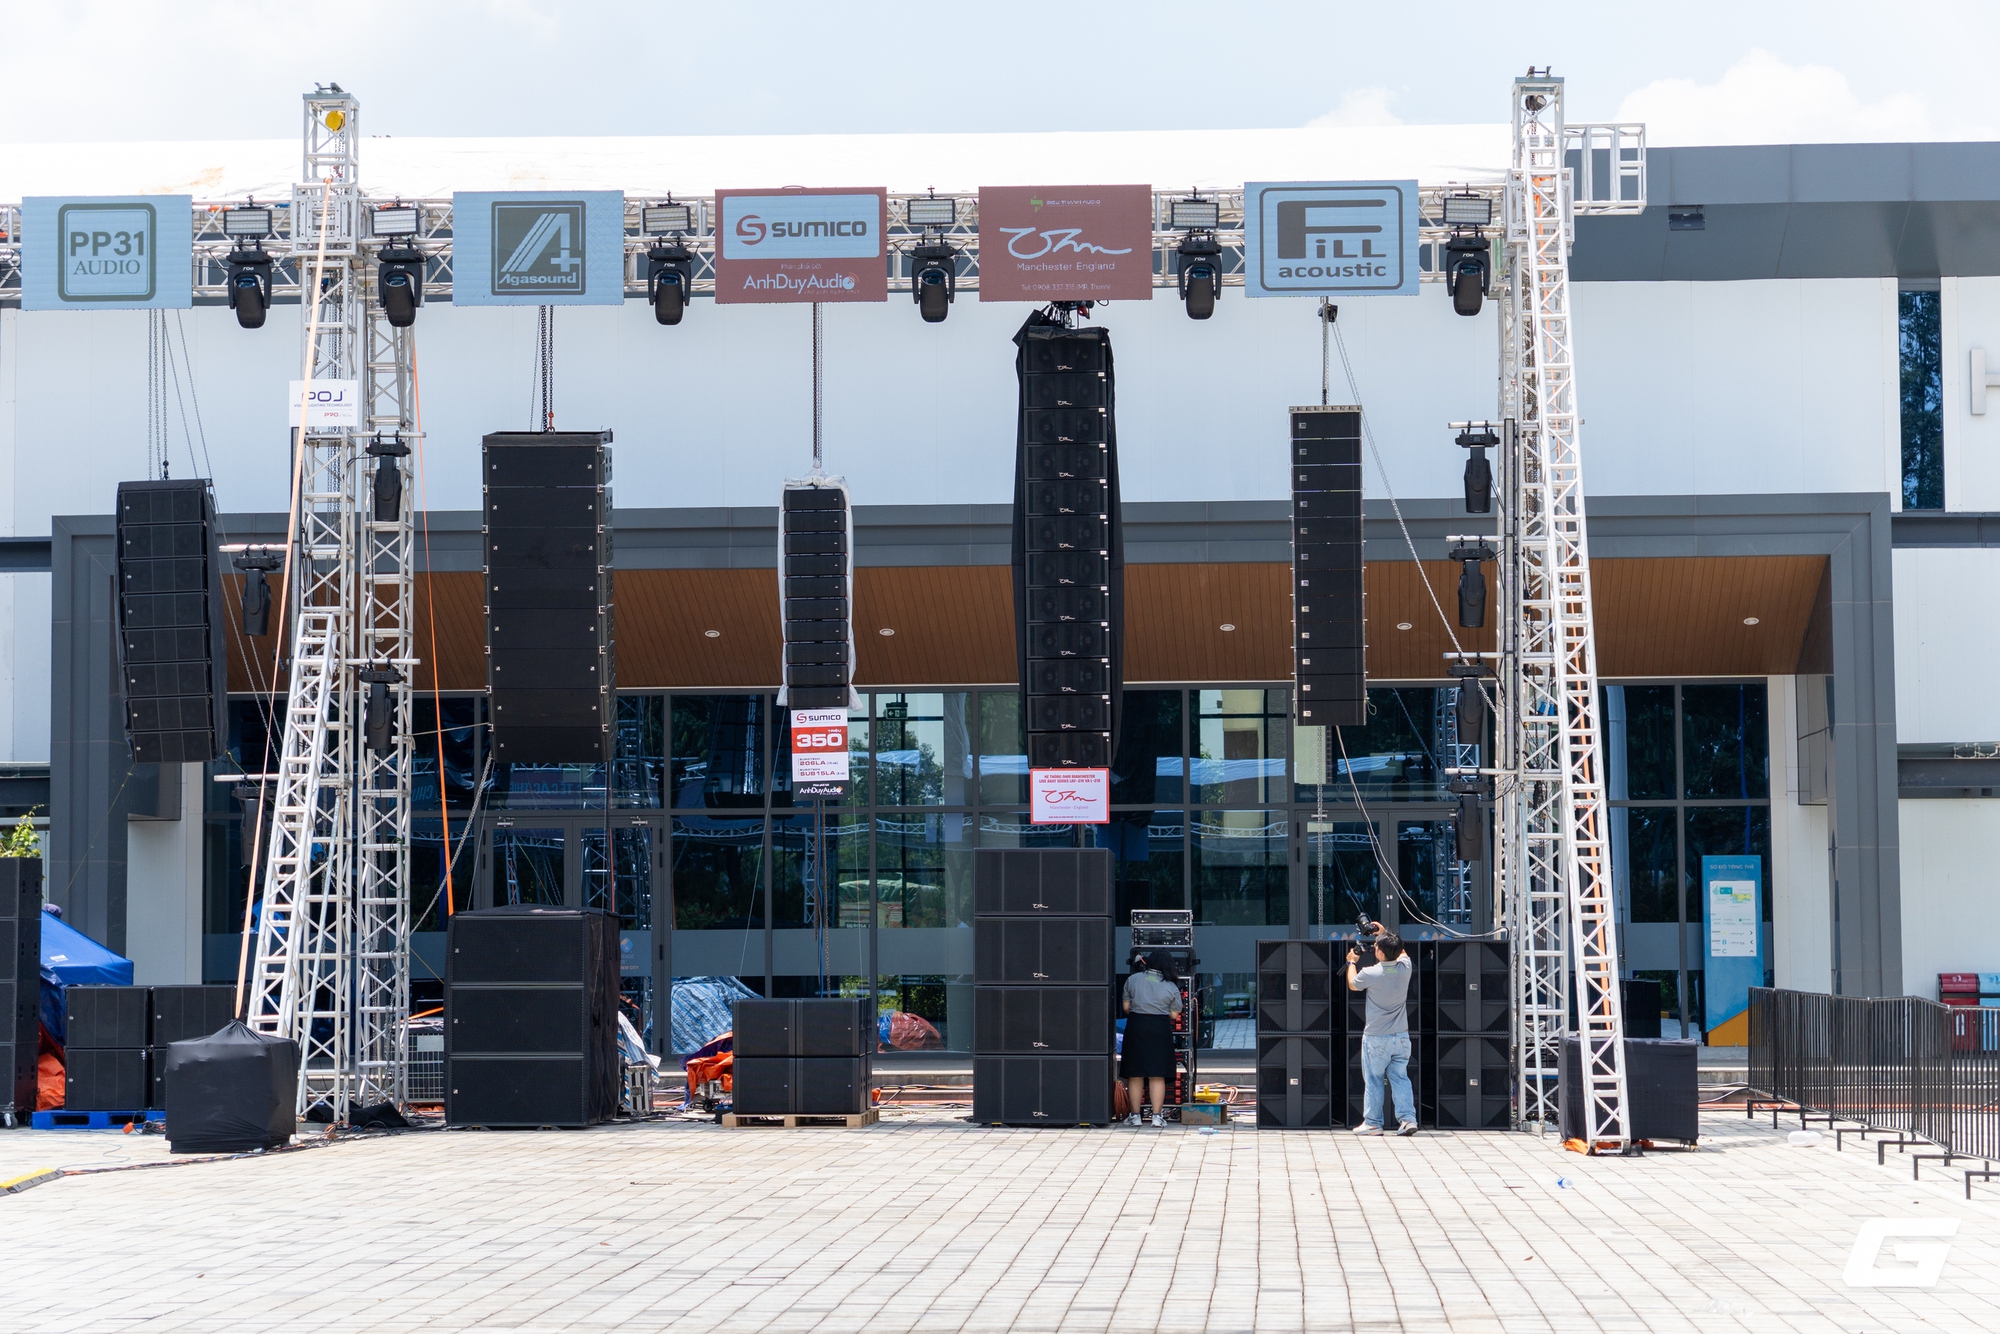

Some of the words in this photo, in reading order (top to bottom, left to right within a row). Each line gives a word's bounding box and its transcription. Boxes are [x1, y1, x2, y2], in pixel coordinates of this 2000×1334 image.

[772, 221, 866, 237] SUMICO
[70, 231, 144, 256] PP31
[73, 260, 140, 275] AUDIO
[1016, 262, 1072, 271] Manchester
[1076, 262, 1116, 272] England
[1278, 262, 1386, 278] acoustic
[498, 272, 576, 286] Agasound
[743, 273, 856, 294] AnhDuyAudio
[796, 733, 842, 747] 350
